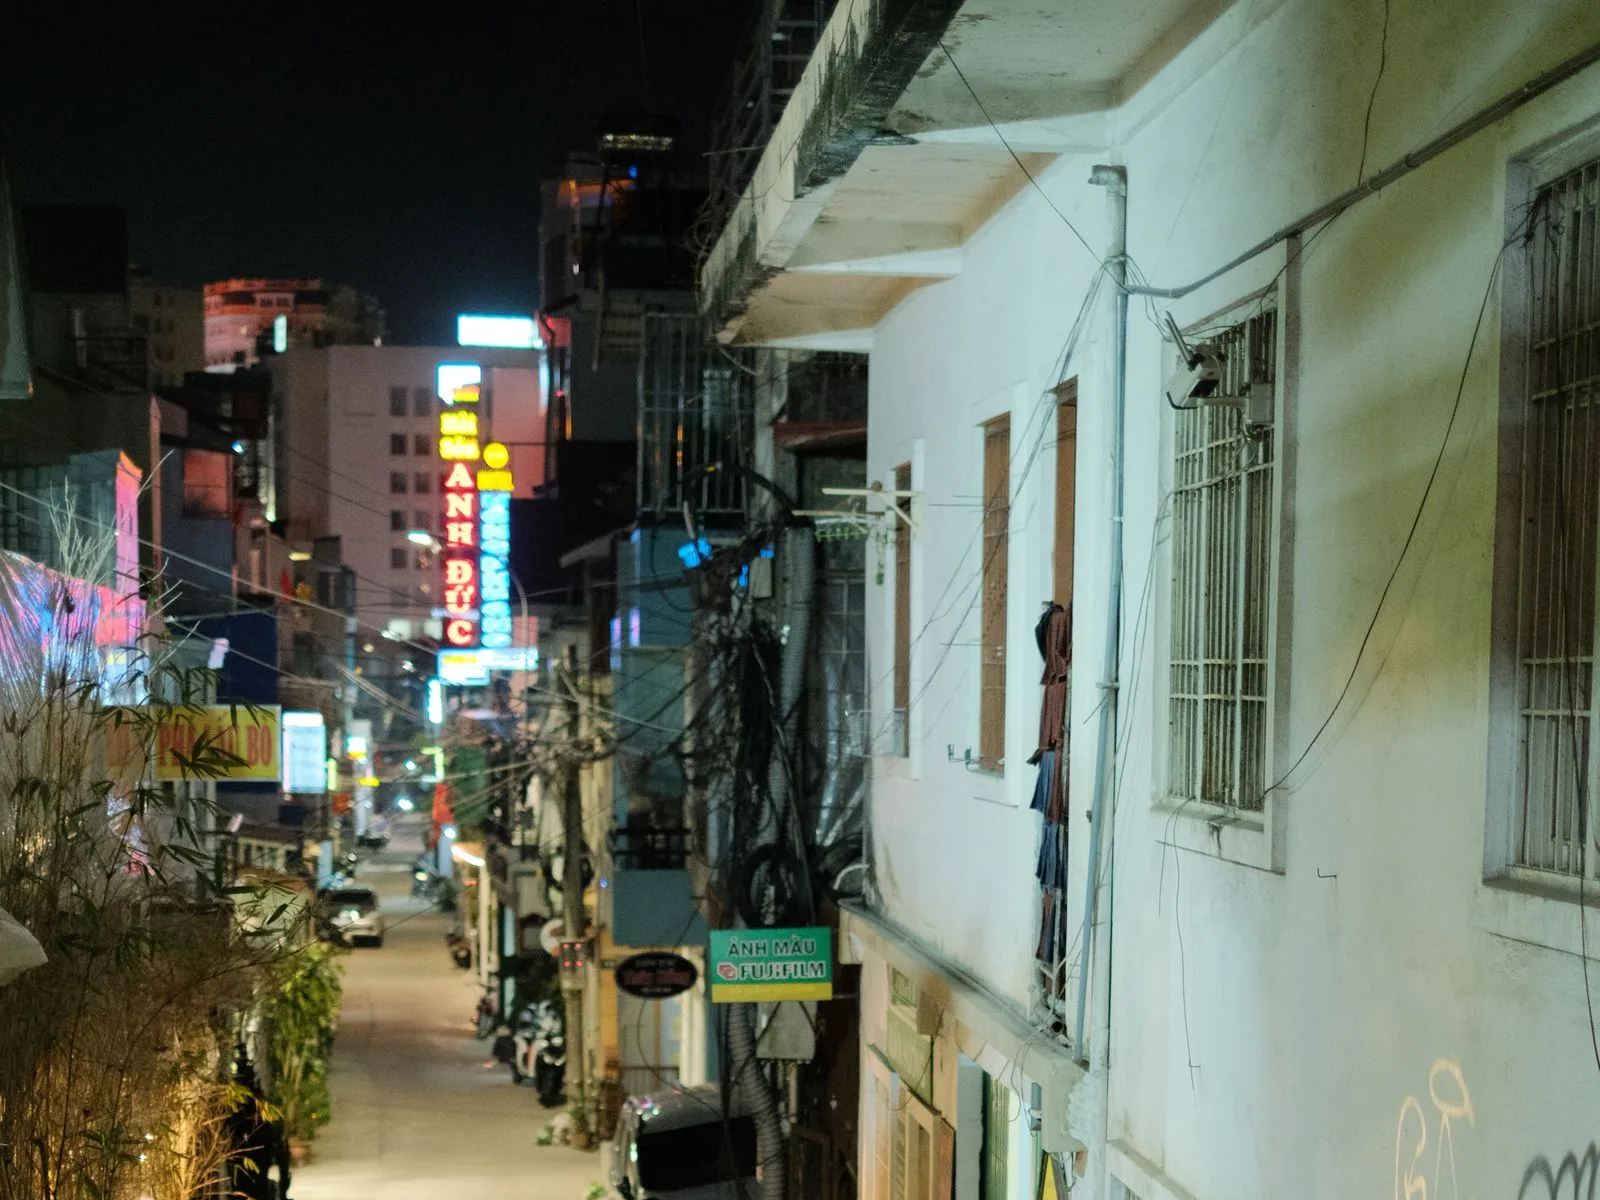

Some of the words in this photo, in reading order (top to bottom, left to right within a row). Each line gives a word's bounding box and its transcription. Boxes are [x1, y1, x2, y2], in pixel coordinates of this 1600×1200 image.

[445, 462, 474, 546] ANH
[444, 560, 475, 645] ĐỨC
[740, 961, 825, 980] FUJIFILM
